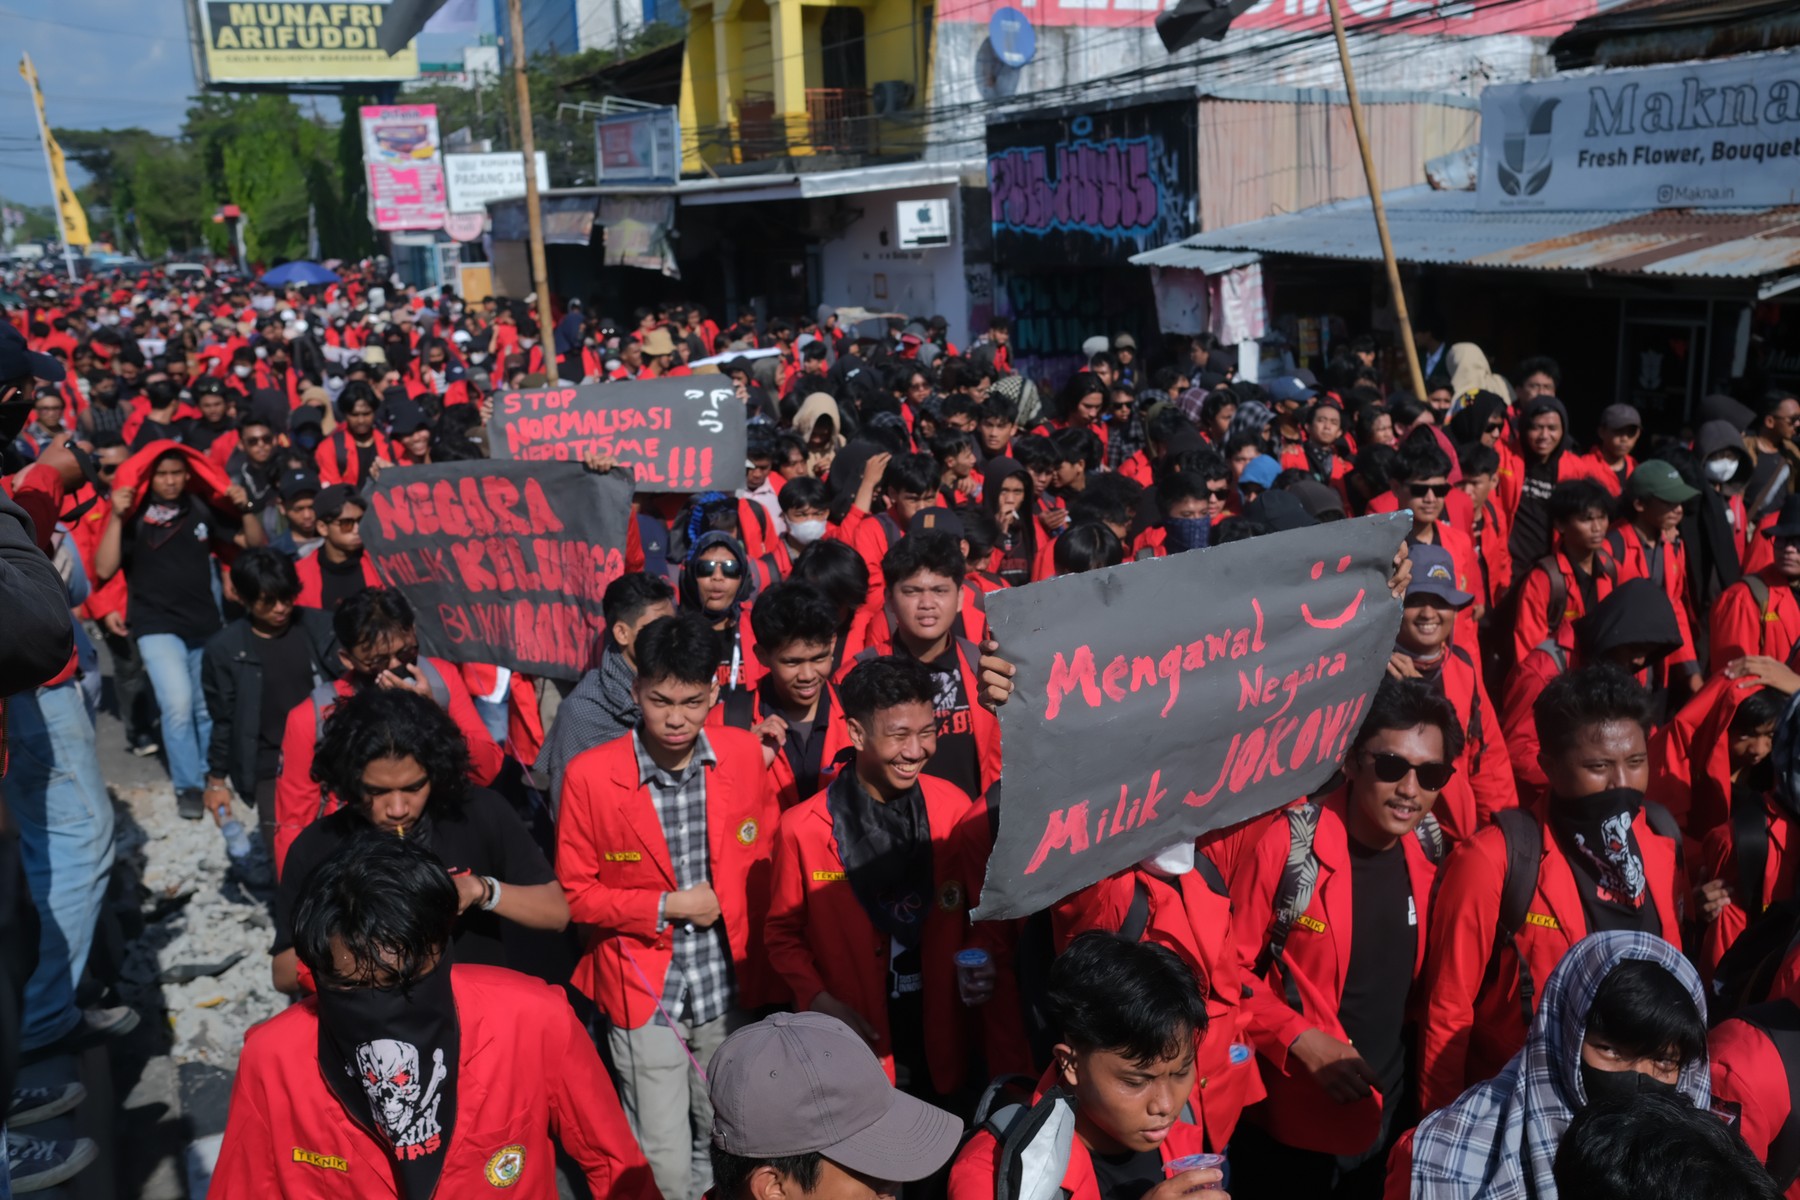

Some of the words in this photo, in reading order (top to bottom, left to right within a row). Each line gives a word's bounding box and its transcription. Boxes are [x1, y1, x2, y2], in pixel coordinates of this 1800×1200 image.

[229, 4, 383, 26] MUNAFRI
[217, 26, 378, 48] ARIFUDDI
[1584, 77, 1800, 137] Makna
[1578, 147, 1627, 168] Fresh
[1632, 144, 1704, 166] Flower,
[503, 389, 577, 413] STOP
[506, 407, 672, 454] NORMALISASI
[372, 475, 564, 541] NEGARA
[377, 547, 454, 587] MILIK
[1045, 598, 1266, 720] Mengawal
[1237, 653, 1347, 724] Negara
[1024, 769, 1167, 875] Milik
[297, 1150, 346, 1171] TEKNIK
